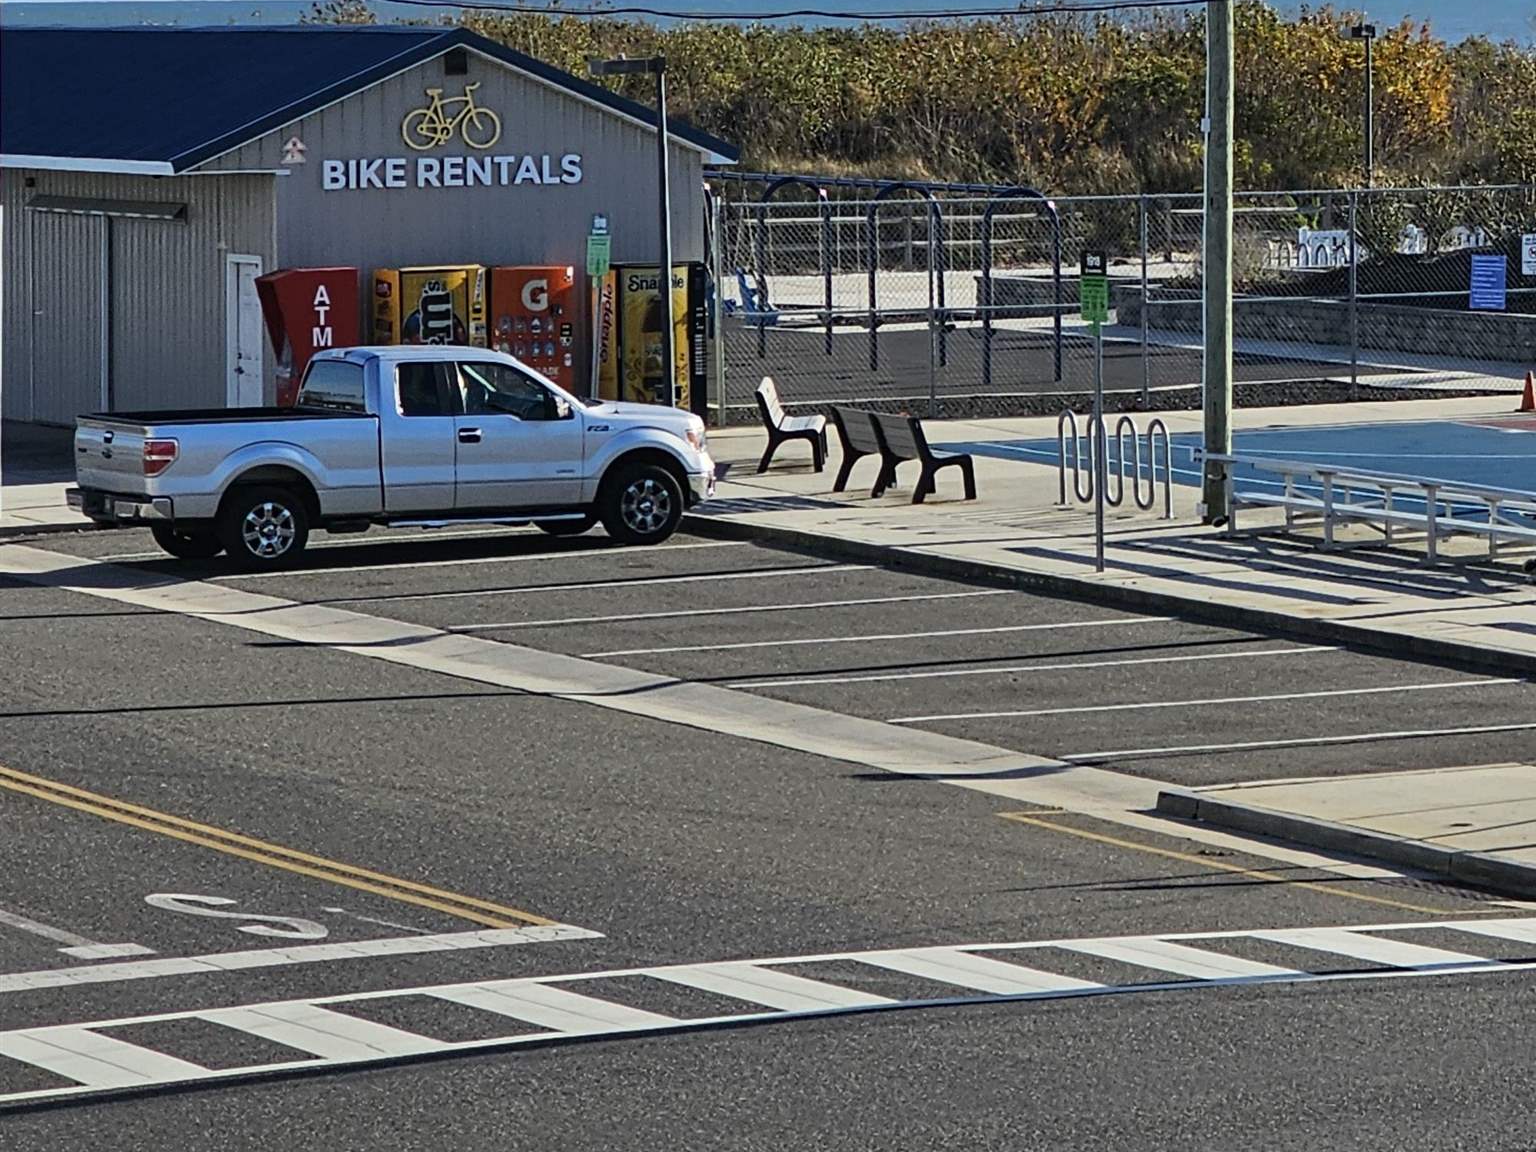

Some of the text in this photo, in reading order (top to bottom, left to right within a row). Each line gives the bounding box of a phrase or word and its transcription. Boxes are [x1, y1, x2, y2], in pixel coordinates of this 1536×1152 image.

[322, 153, 583, 190] BIKE RENTALS
[521, 279, 549, 312] G
[627, 274, 684, 292] Snale
[312, 284, 333, 347] ATM
